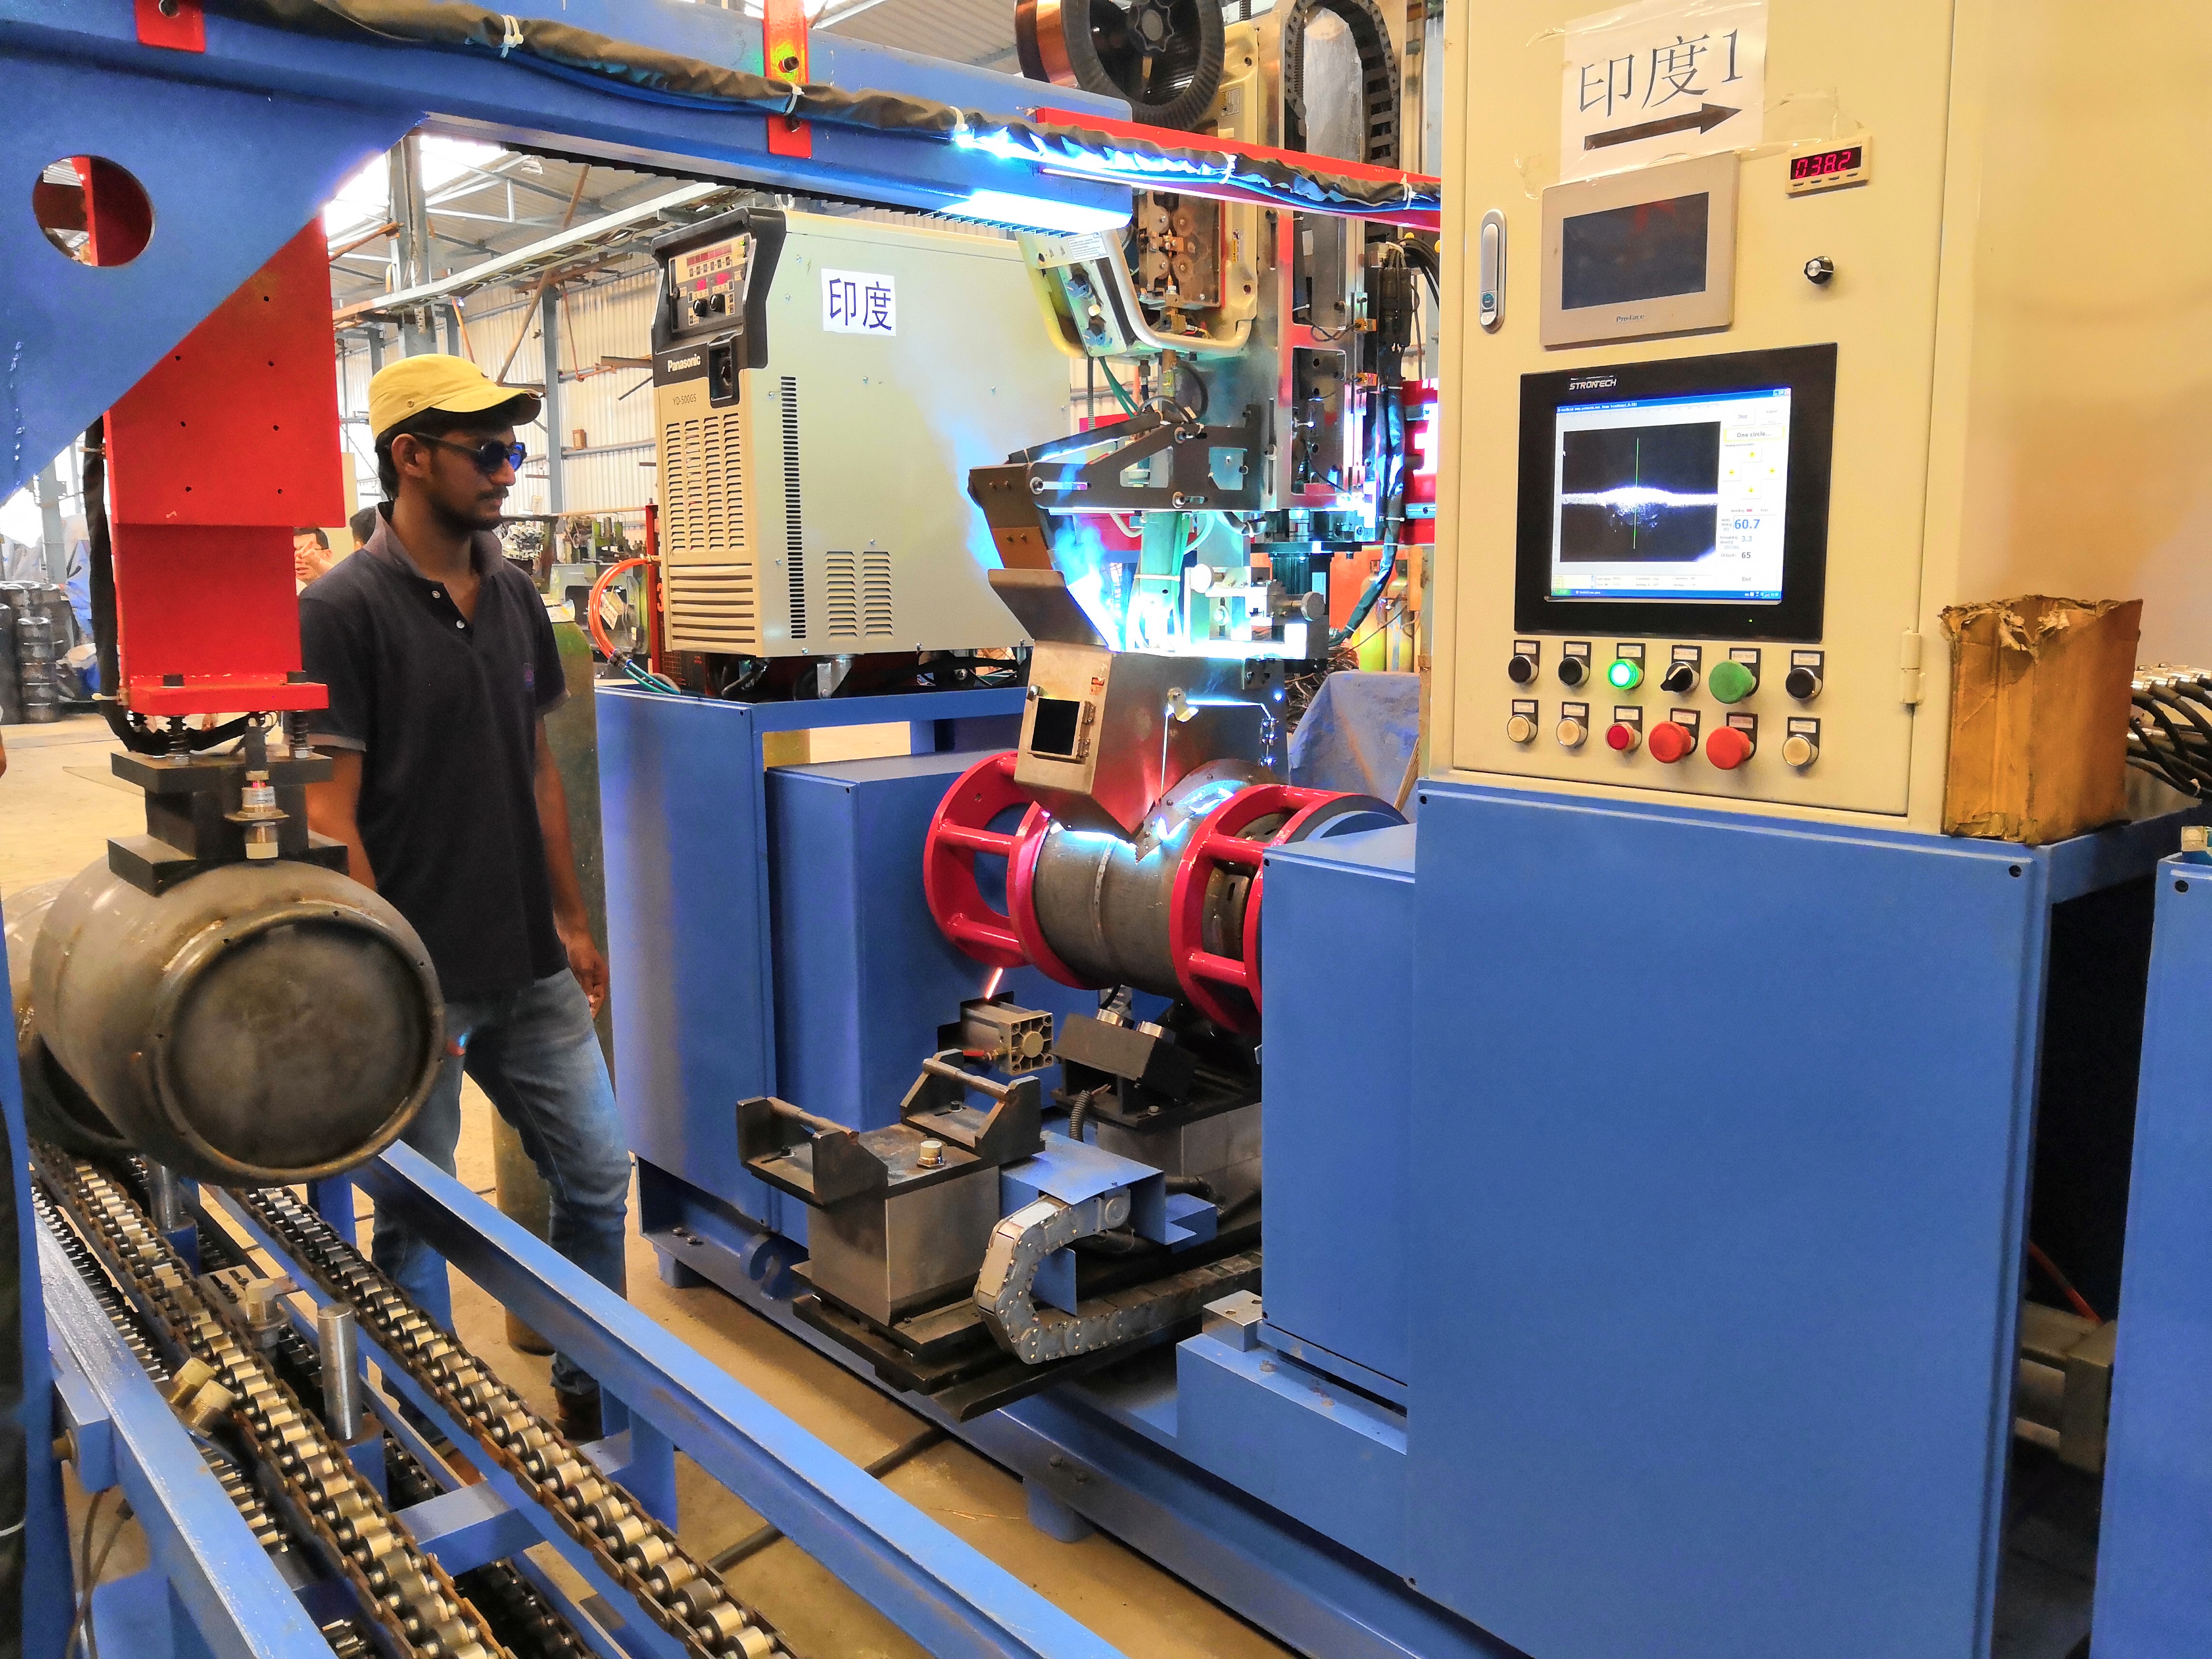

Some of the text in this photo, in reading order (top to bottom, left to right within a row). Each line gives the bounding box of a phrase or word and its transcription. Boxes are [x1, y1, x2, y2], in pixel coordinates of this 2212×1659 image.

[1579, 28, 1743, 118] 印度1
[830, 278, 891, 331] 印度
[667, 353, 701, 373] Panasonic
[673, 394, 697, 405] YD-500GS
[1734, 519, 1760, 529] 60.7
